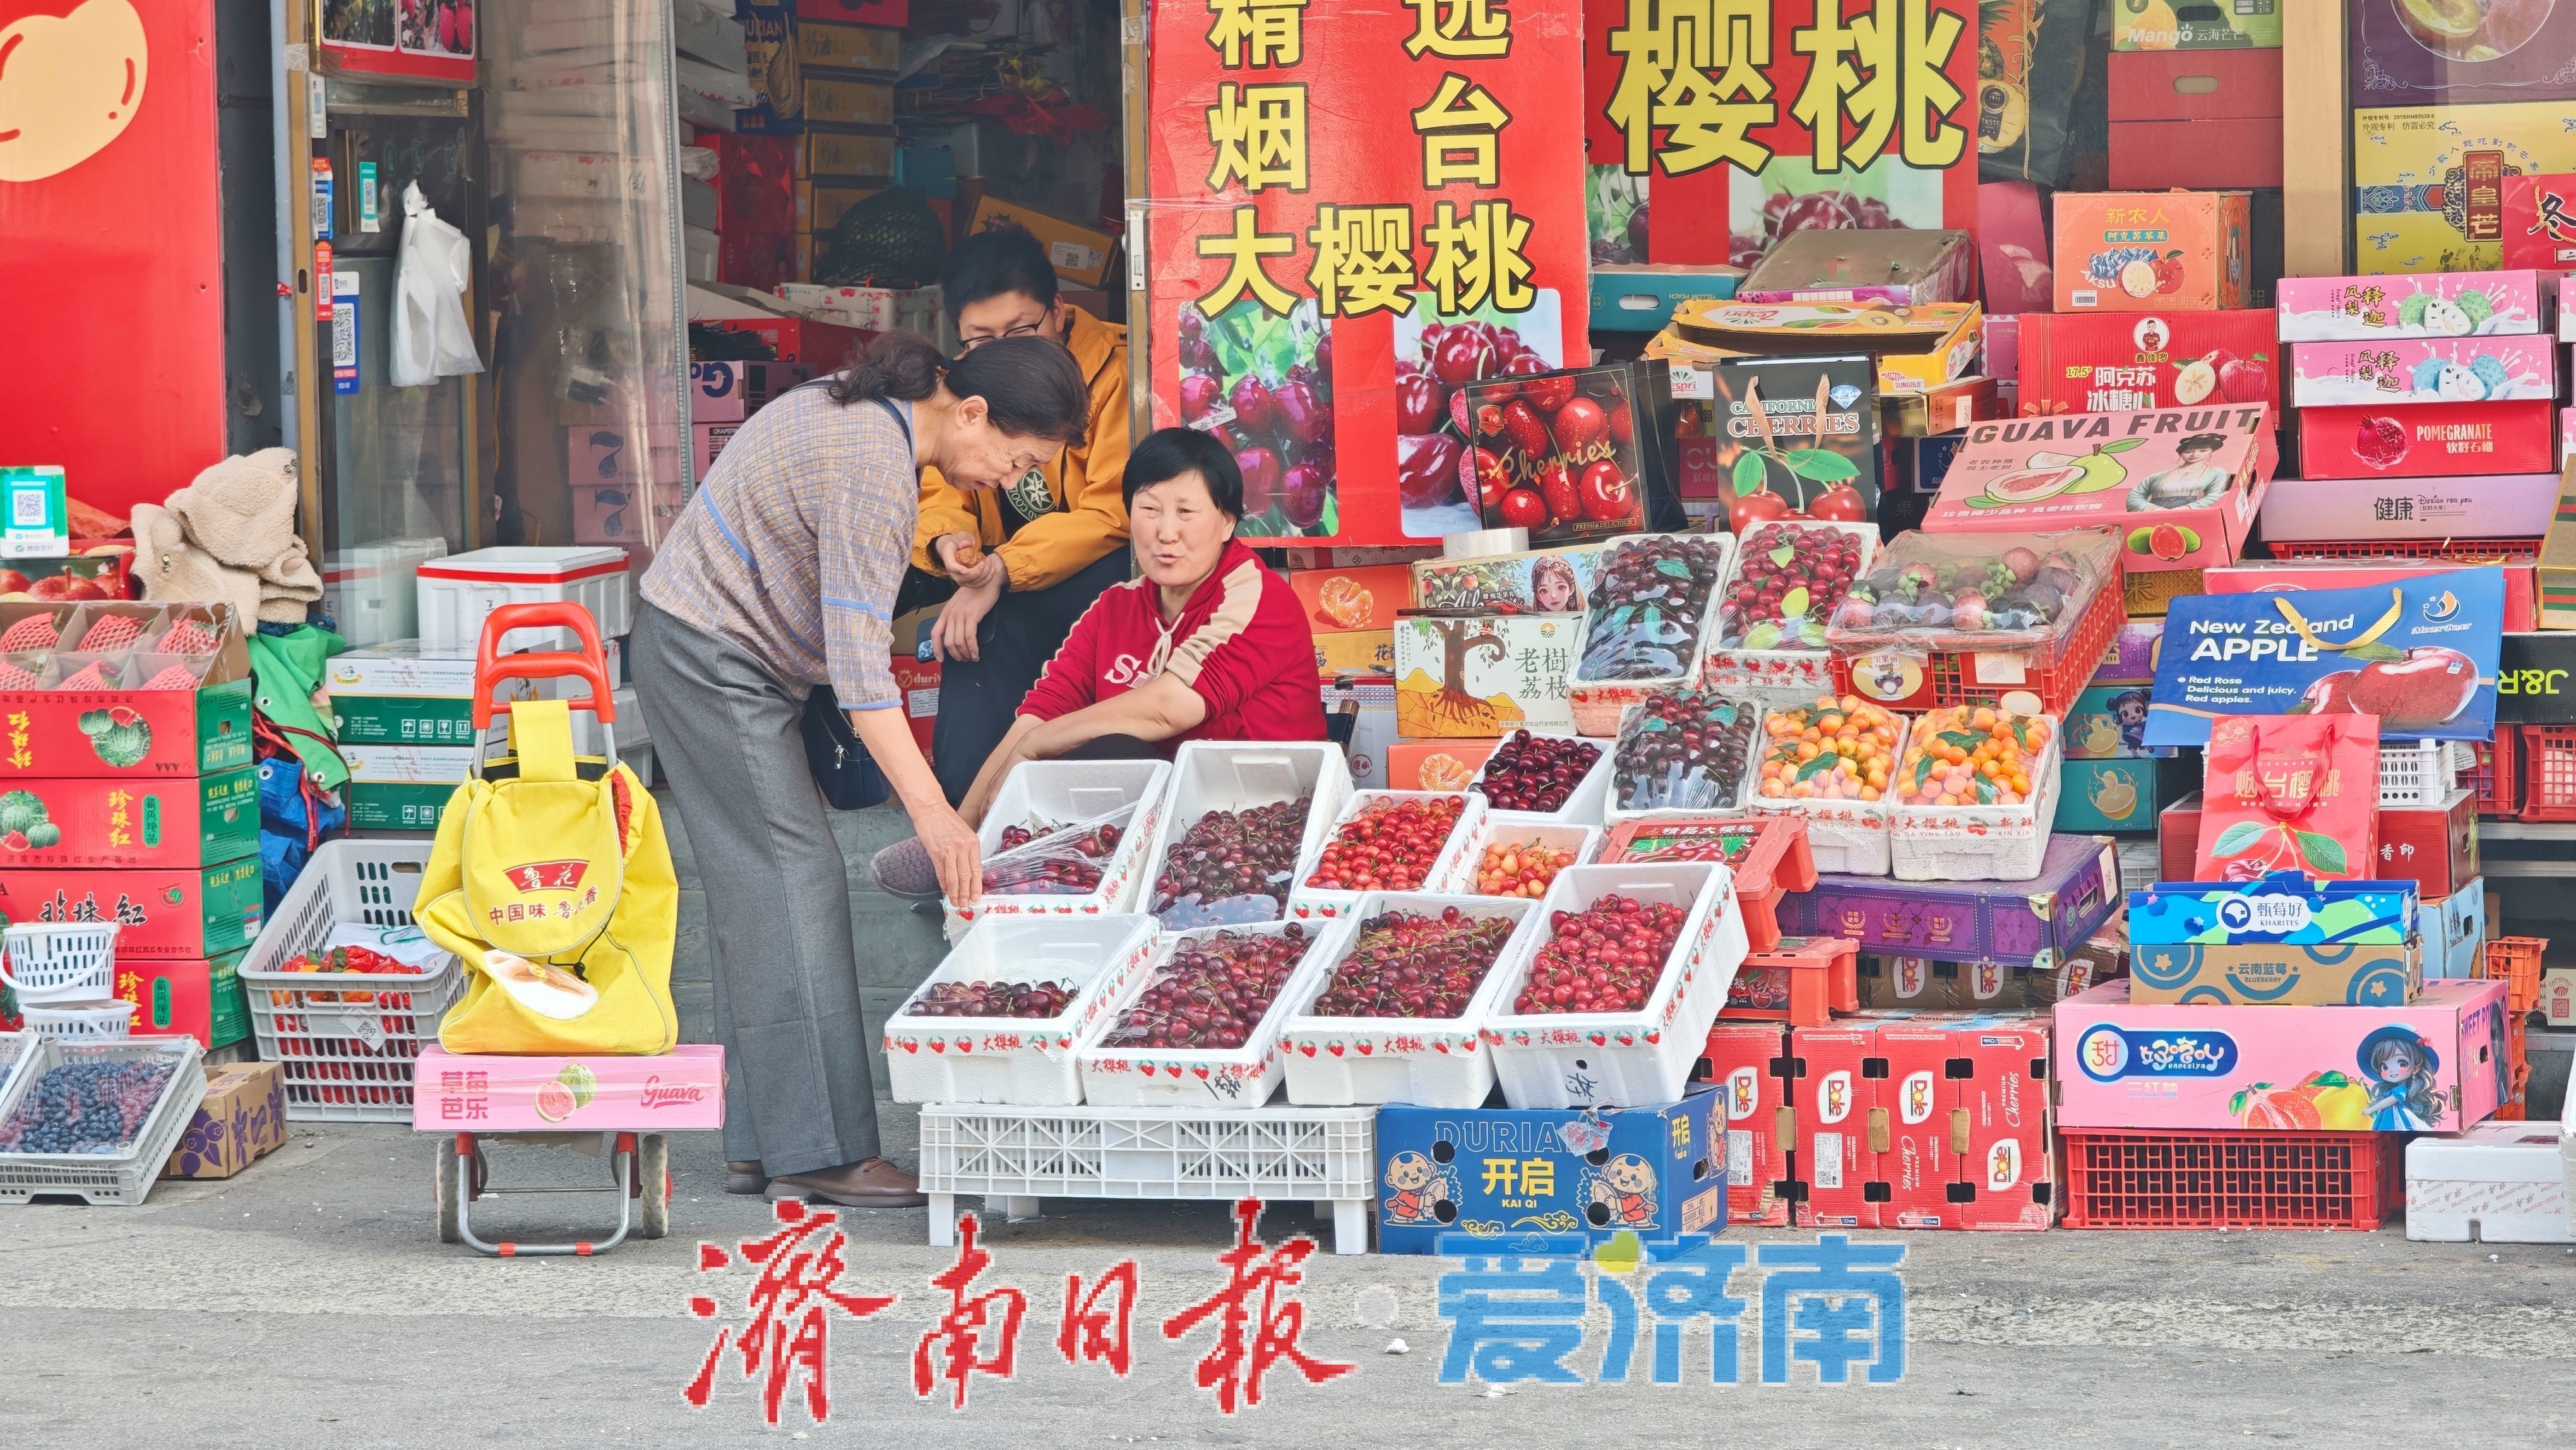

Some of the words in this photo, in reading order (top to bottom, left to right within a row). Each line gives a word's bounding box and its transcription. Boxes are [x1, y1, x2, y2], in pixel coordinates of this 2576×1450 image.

[746, 19, 782, 36] URIAN
[1207, 0, 1303, 68] 精
[2127, 27, 2193, 46] Mango
[2197, 28, 2245, 41] 云海芒芒
[1606, 0, 1968, 177] 樱桃
[1207, 82, 1311, 192] 烟
[1410, 75, 1513, 189] 台
[2362, 122, 2395, 131] 外观专利
[2106, 208, 2170, 225] 新农人
[2107, 231, 2166, 242] 阿克苏苹果
[1196, 201, 1537, 320] 大樱桃
[2344, 285, 2361, 316] 凤梨
[2362, 285, 2388, 328] 释迦
[1723, 309, 1780, 321] Zespri
[2135, 352, 2168, 364] 鑫佳罗
[2359, 350, 2376, 381] 凤梨
[2066, 366, 2093, 379] 17.5°
[2095, 365, 2156, 388] 阿克苏
[2376, 350, 2402, 393] 释迦
[1670, 381, 1697, 393] espri
[1895, 381, 1921, 389] SUNGOLD
[2087, 389, 2156, 412] 冰糖心
[1971, 417, 2114, 445] GUAVA
[2127, 408, 2261, 436] FRUIT
[2416, 424, 2493, 442] POMEGRANATE
[2446, 440, 2493, 453] 软籽石榴
[1501, 438, 1617, 490] Cherries
[1896, 500, 1914, 518] 果
[2374, 496, 2414, 522] 健康
[2190, 620, 2247, 635] New
[1513, 647, 1569, 674] 老樹
[2190, 638, 2320, 662] APPLE
[1518, 675, 1568, 701] 荔枝
[2187, 686, 2239, 694] Delicious
[2241, 685, 2265, 694] and
[2267, 686, 2296, 696] juicy.
[2497, 669, 2569, 695] J&R
[2210, 695, 2253, 705] apples.
[7, 710, 33, 769] 珍珠红
[108, 789, 134, 848] 珍珠红
[7, 855, 138, 865] 济南市珍珠红生产基地
[2380, 843, 2414, 863] 香印
[519, 863, 576, 890] 鲁花
[489, 903, 547, 926] 中国味
[552, 885, 599, 920] 鲁花香
[2257, 902, 2302, 918] 甄莓好
[2238, 963, 2287, 975] 云南蓝莓
[2092, 1040, 2120, 1067] 甜
[440, 1071, 489, 1094] 草莓
[641, 1075, 705, 1109] Guava
[1738, 1076, 1753, 1113] Dole
[2126, 1081, 2178, 1098] 三红柚
[440, 1096, 489, 1120] 芭乐
[1831, 1080, 1845, 1117] Dole
[1913, 1080, 1929, 1117] Dole
[2005, 1071, 2019, 1127] Cherries
[1434, 1121, 1572, 1153] DURIA
[1671, 1113, 1690, 1149] 开启
[1900, 1135, 1916, 1192] Cherries
[1993, 1146, 2008, 1183] Dole
[1481, 1157, 1554, 1197] 开启
[1501, 1199, 1522, 1207] KAI
[1525, 1199, 1537, 1208] QI
